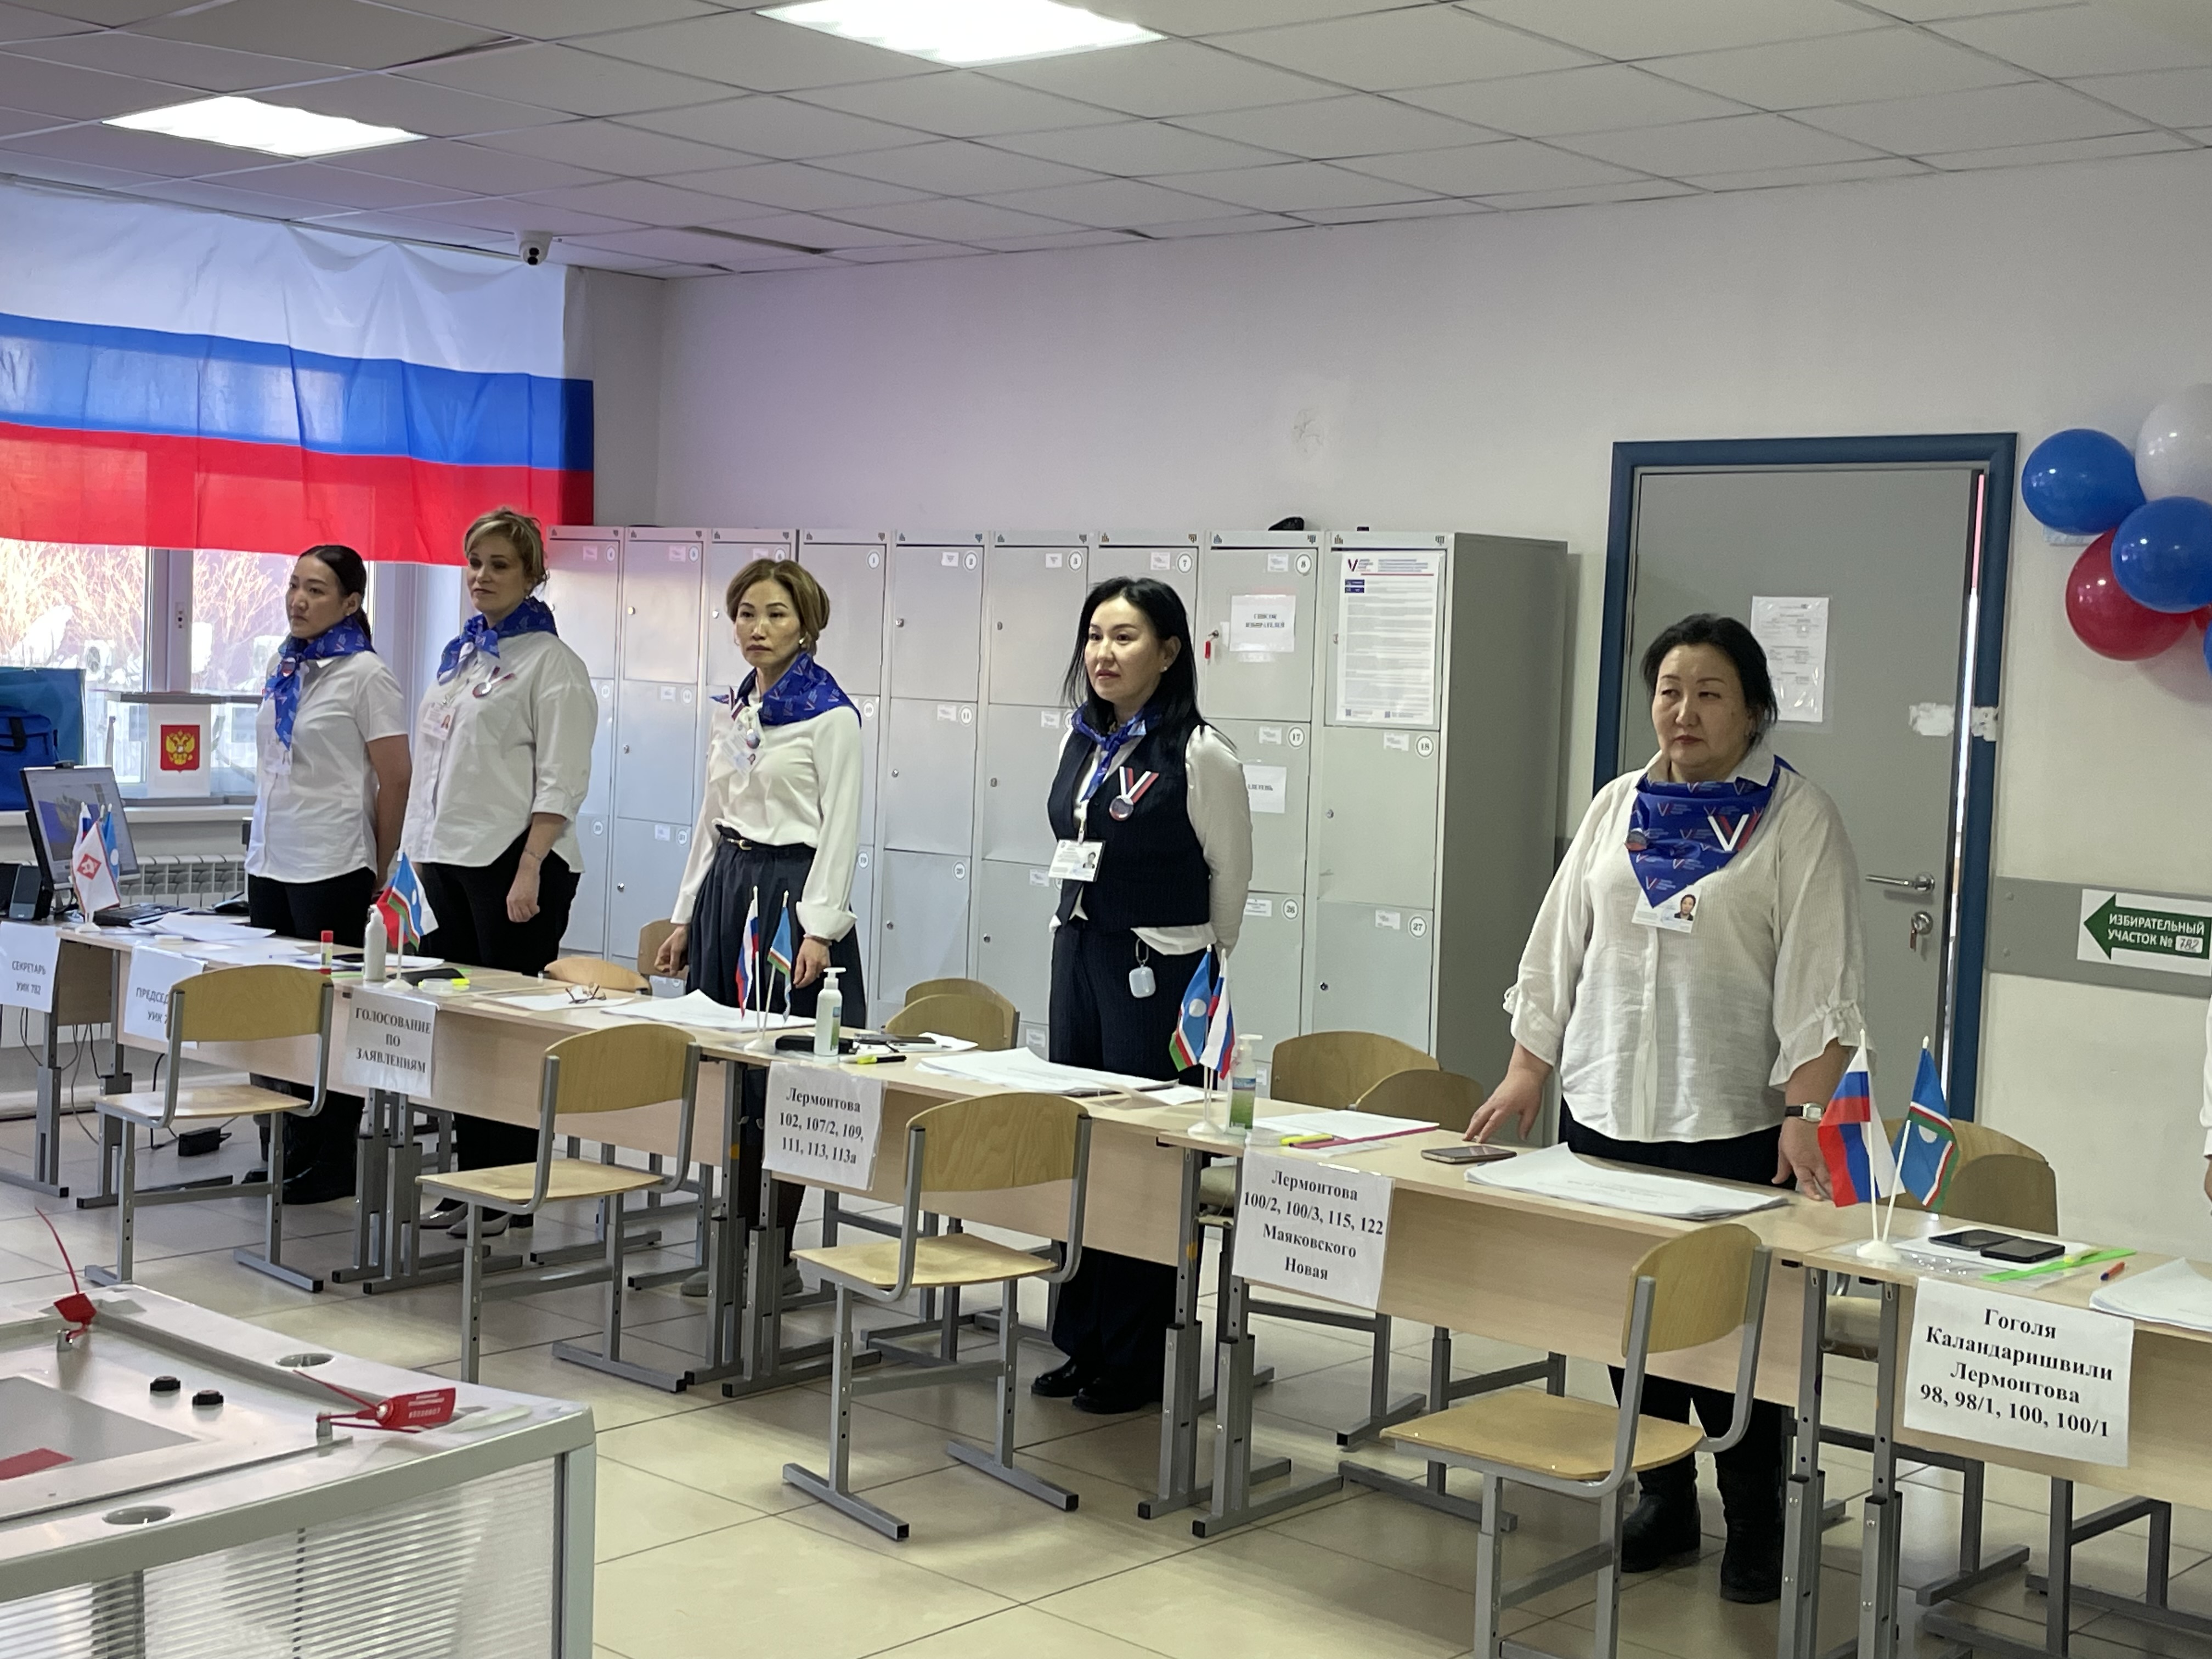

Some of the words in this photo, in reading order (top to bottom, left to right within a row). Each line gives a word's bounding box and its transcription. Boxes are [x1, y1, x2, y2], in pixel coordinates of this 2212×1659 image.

[1292, 733, 1301, 741] 17
[1413, 922, 1423, 932] 27
[2109, 913, 2204, 935] ИЗБИРАТЕЛЬНЫЙ
[2108, 929, 2157, 945] УЧАСТОК
[2180, 938, 2199, 950] 782
[12, 961, 46, 975] СЕКРЕТАРЬ
[136, 988, 169, 1005] ПРЕДСЕД
[356, 1008, 431, 1034] ГОЛОСОВАНИЕ
[386, 1034, 400, 1047] ПО
[356, 1047, 426, 1073] ЗАЯВЛЕНИЯМ
[786, 1087, 860, 1113] Лермонтова
[780, 1112, 802, 1131] 102,
[806, 1117, 838, 1137] 107/2,
[843, 1124, 864, 1142] 109,
[782, 1137, 804, 1154] 111,
[808, 1142, 828, 1160] 113,
[832, 1147, 857, 1164] 113а
[1272, 1170, 1358, 1201] Лермонтова
[1244, 1192, 1281, 1215] 100/2,
[1286, 1201, 1323, 1223] 100/3,
[1329, 1210, 1355, 1231] 115,
[1361, 1217, 1384, 1235] 122
[1263, 1223, 1356, 1257] Маяковского
[1285, 1256, 1328, 1280] Новая
[1984, 1308, 2057, 1339] Гоголя
[1926, 1326, 2113, 1381] Каландаришвили
[1950, 1361, 2080, 1403] Лермонтова
[1920, 1384, 1949, 1407] 98,
[1955, 1391, 2001, 1418] 98/1,
[2010, 1403, 2049, 1427] 100,
[2057, 1413, 2108, 1437] 100/1
